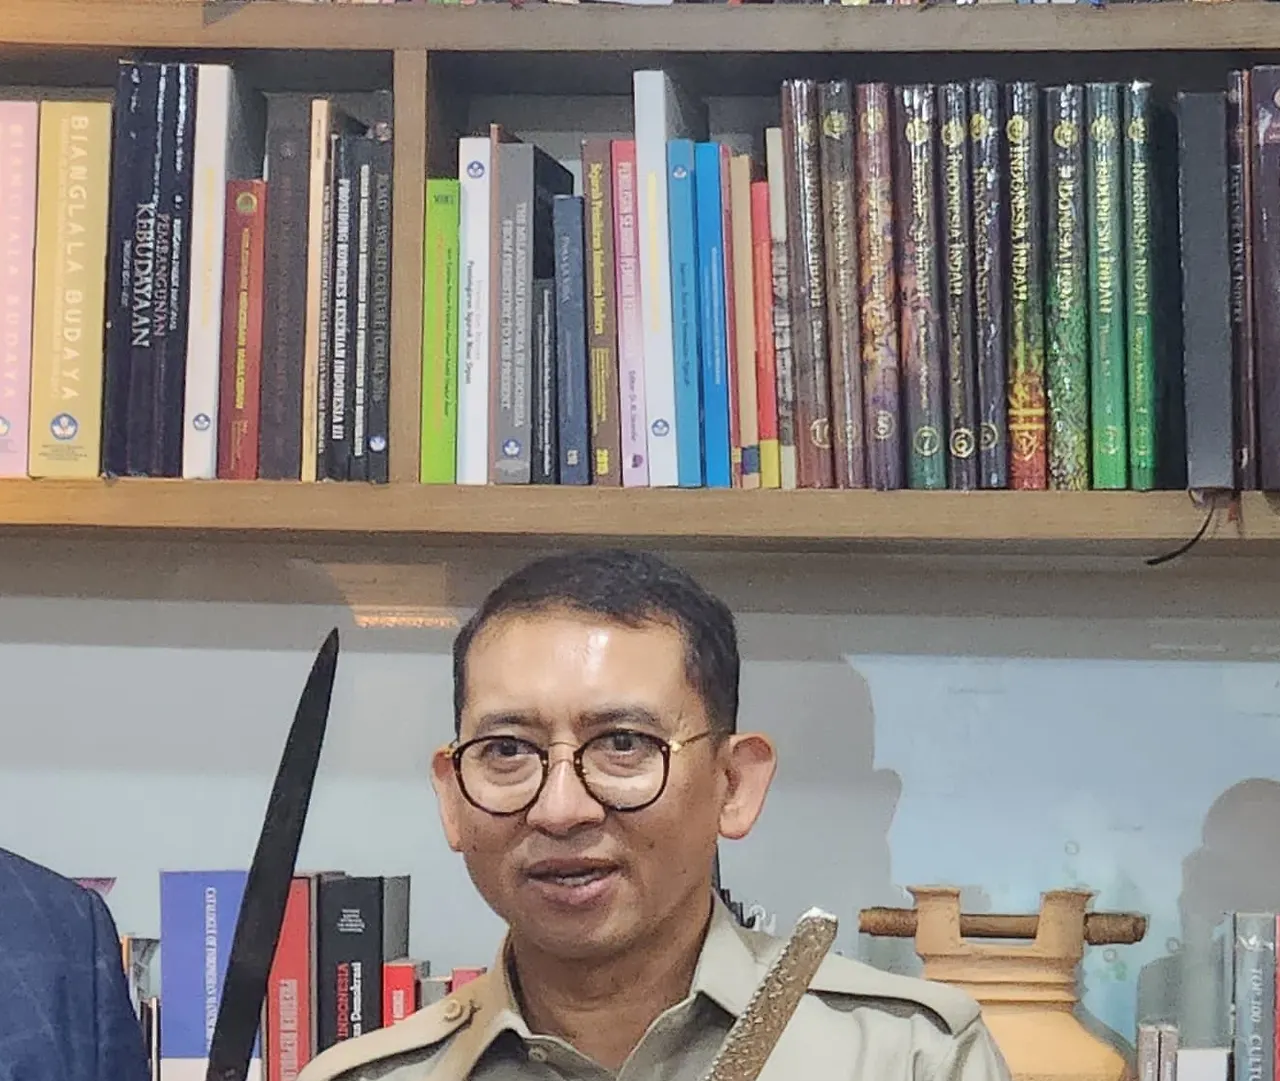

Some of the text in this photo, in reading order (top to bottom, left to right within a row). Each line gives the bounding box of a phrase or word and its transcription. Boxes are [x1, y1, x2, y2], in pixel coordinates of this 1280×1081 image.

[61, 116, 89, 401] BIANGLALA BUDAYA
[337, 179, 350, 241] PROSIDING
[1009, 147, 1030, 300] INDONESIA INDAH
[131, 203, 154, 347] KEBUDAYAAN
[153, 211, 170, 337] PEMBANGUNAN
[948, 241, 966, 296] INDAH
[4, 295, 20, 399] BUDAYA
[332, 360, 346, 421] INDONESIA
[512, 367, 526, 427] INDONESIA
